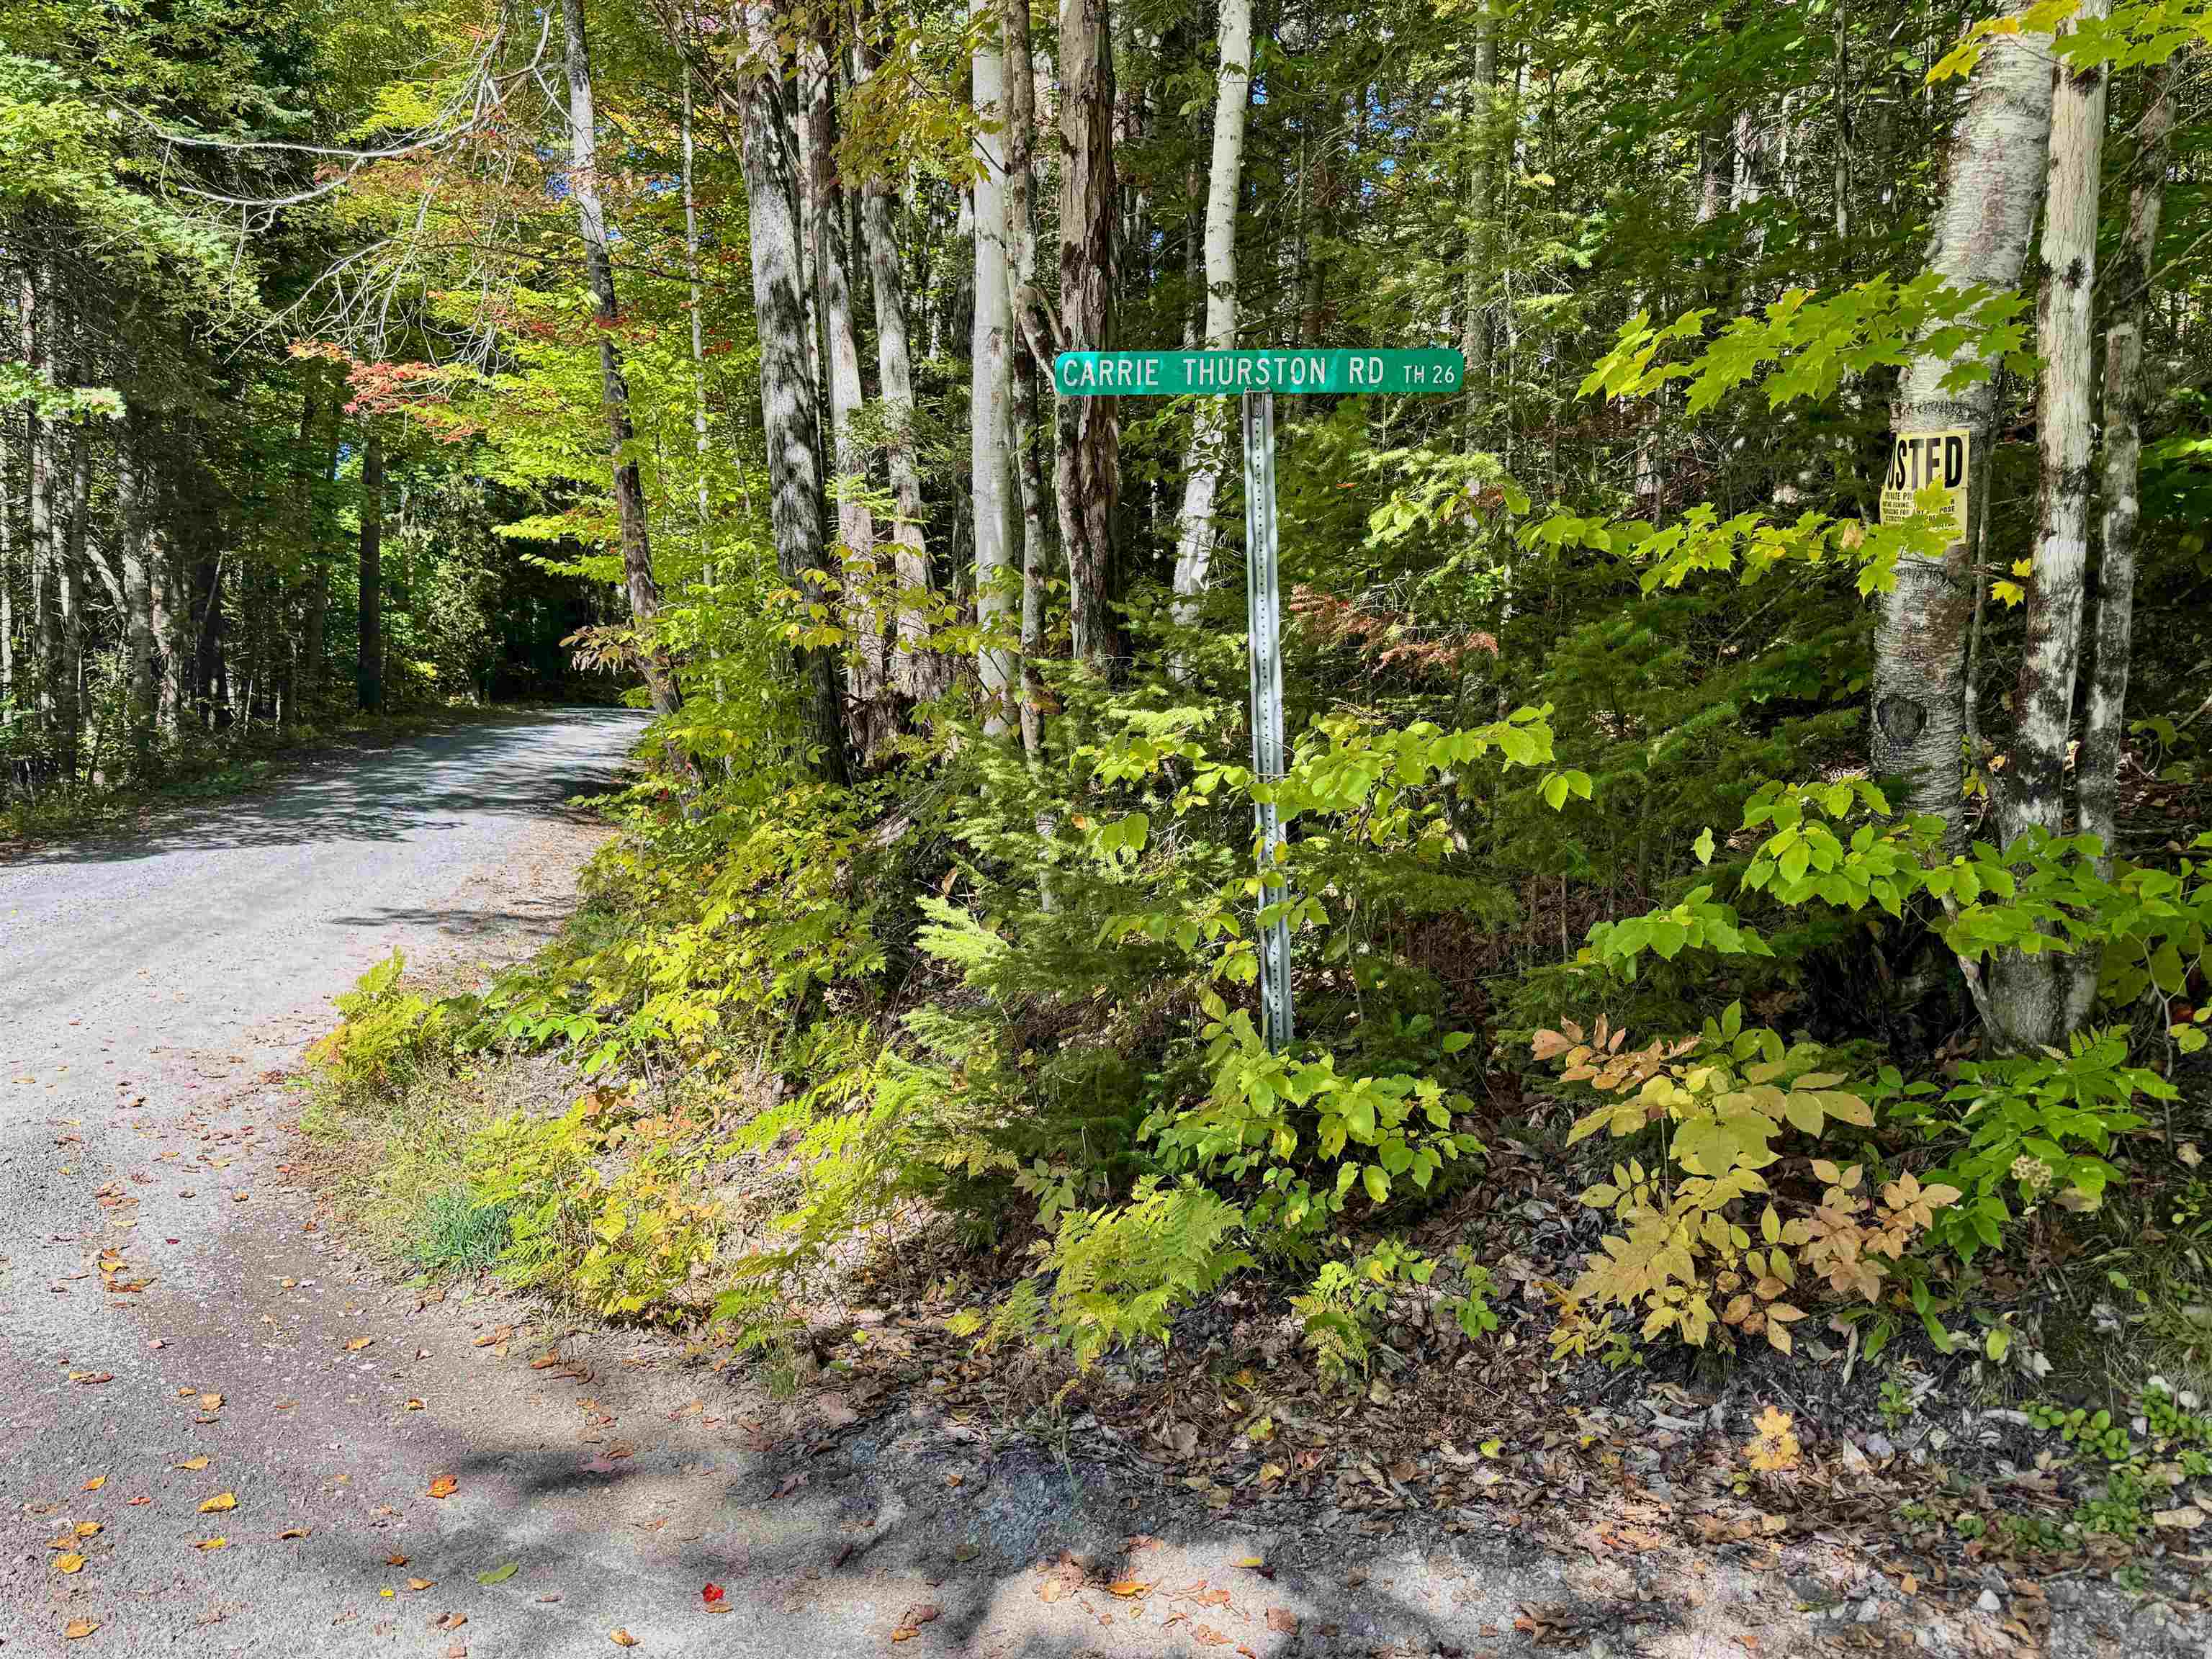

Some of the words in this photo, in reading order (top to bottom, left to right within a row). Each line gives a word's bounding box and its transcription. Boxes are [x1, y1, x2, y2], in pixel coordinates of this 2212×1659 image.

[1063, 358, 1159, 387] CARRIE
[1182, 356, 1326, 386] THURSTON
[1349, 356, 1384, 385] RD
[1403, 365, 1425, 384] TH
[1432, 364, 1455, 384] 26
